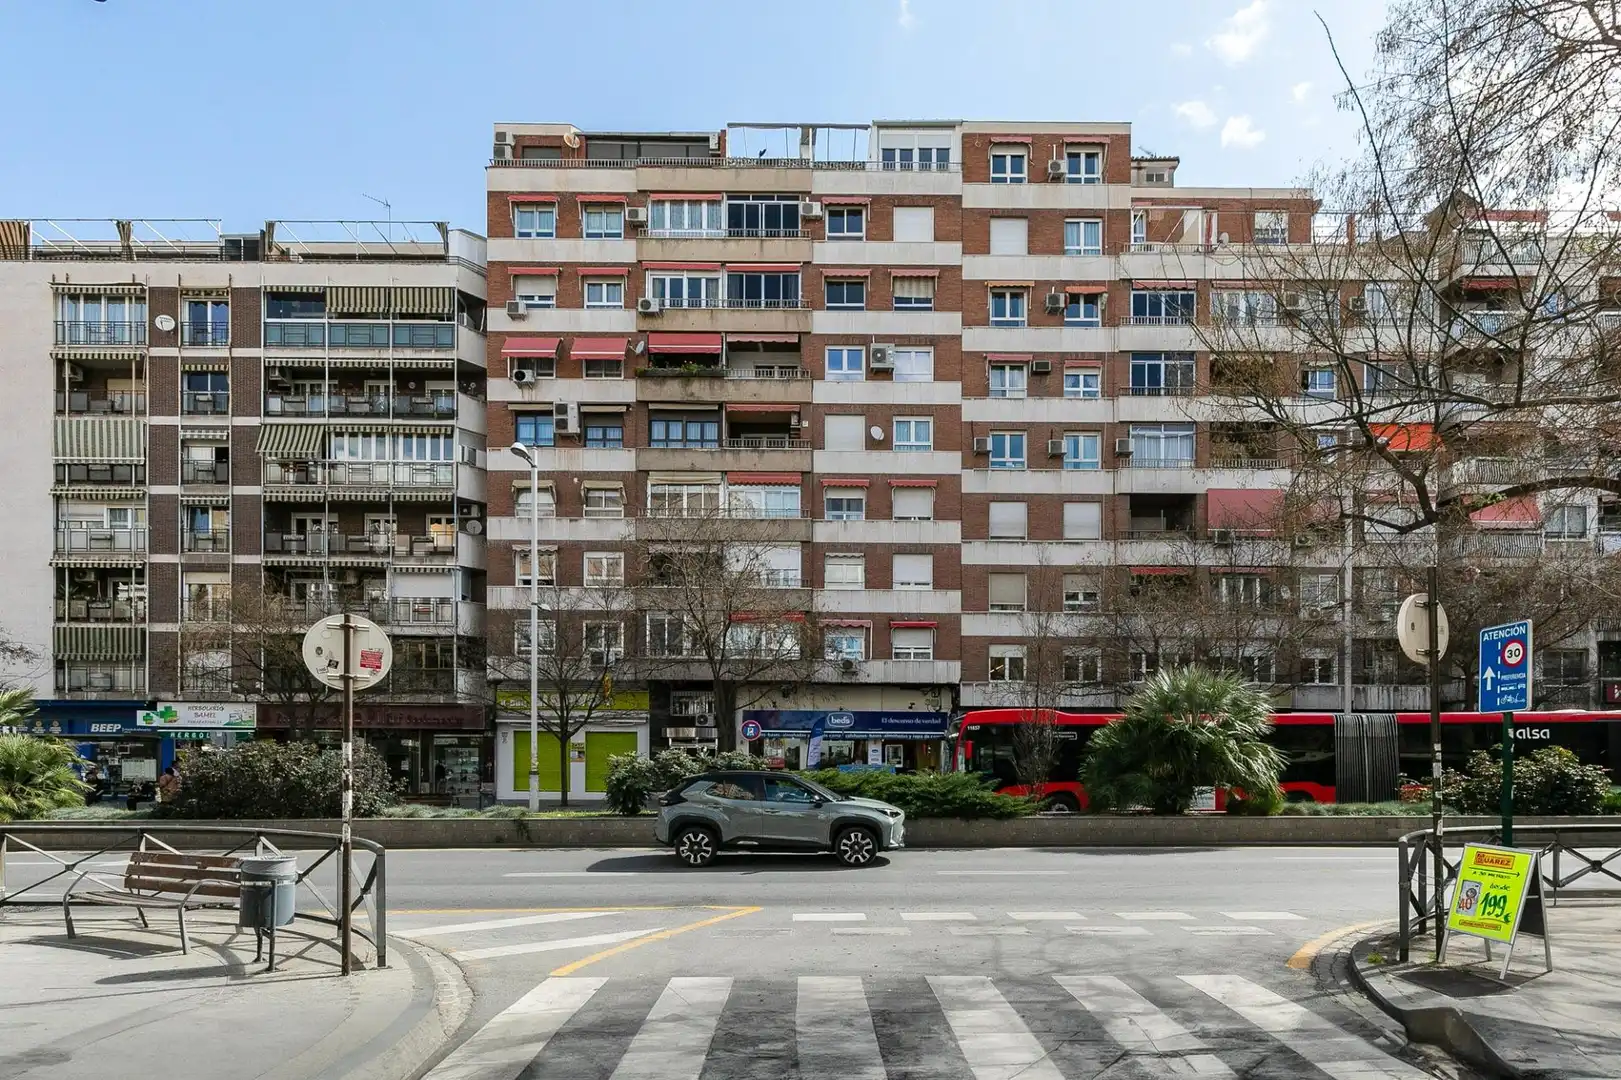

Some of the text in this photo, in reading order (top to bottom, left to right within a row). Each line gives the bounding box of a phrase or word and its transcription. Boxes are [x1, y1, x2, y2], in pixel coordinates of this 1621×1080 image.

[1483, 625, 1526, 642] ATENCIÓN
[1506, 648, 1521, 659] 30
[90, 723, 121, 733] BEEP
[1515, 727, 1551, 740] alsa
